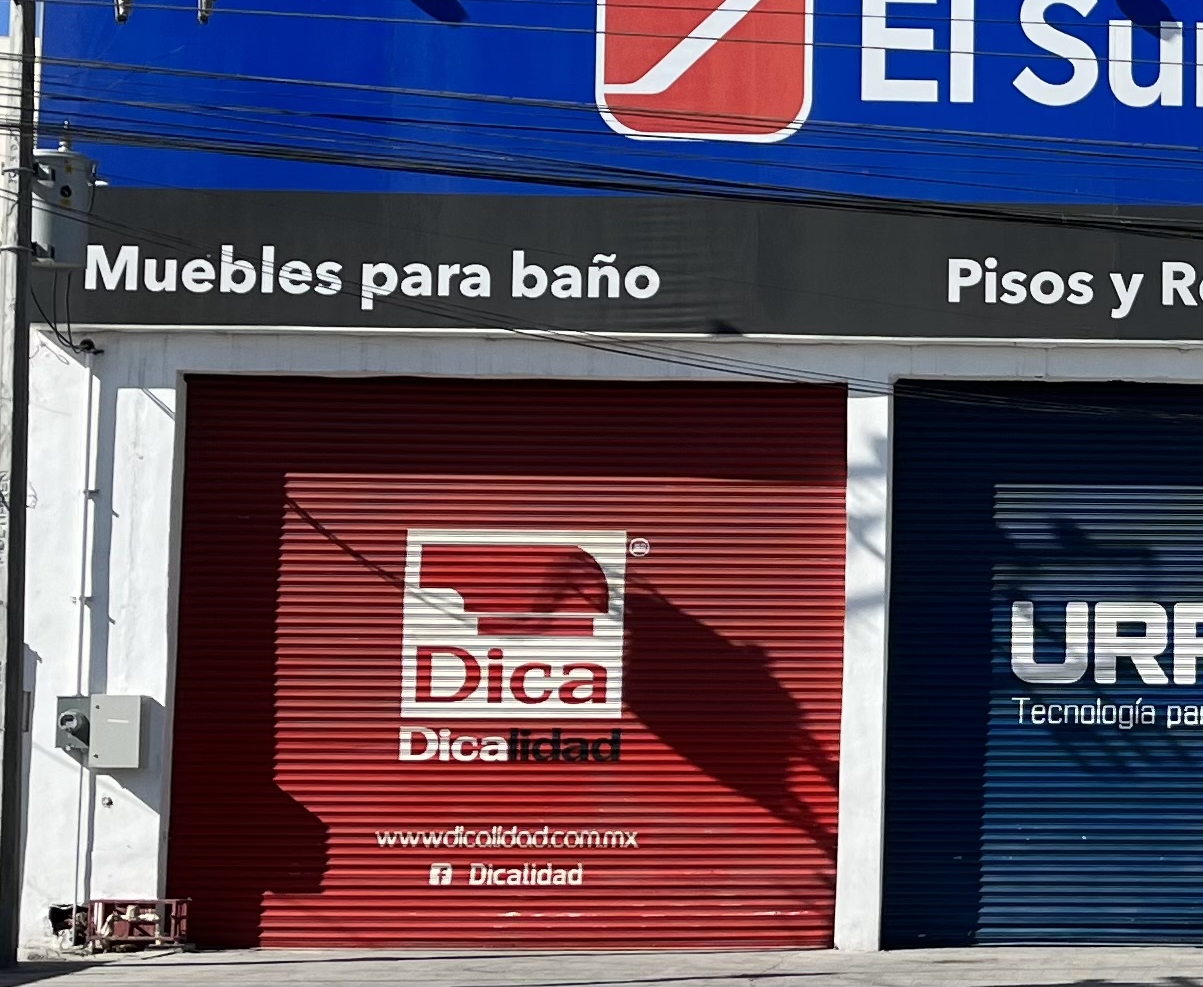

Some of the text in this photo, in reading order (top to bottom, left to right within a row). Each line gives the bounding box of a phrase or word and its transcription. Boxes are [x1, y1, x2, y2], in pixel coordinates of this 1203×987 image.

[84, 244, 661, 310] Muebles para baño
[948, 257, 1095, 305] Pisos
[1109, 272, 1145, 319] y
[415, 646, 609, 704] Dica
[1011, 697, 1157, 730] Tecnología
[398, 725, 622, 762] Dicalidad
[468, 862, 584, 886] Dicalidad
